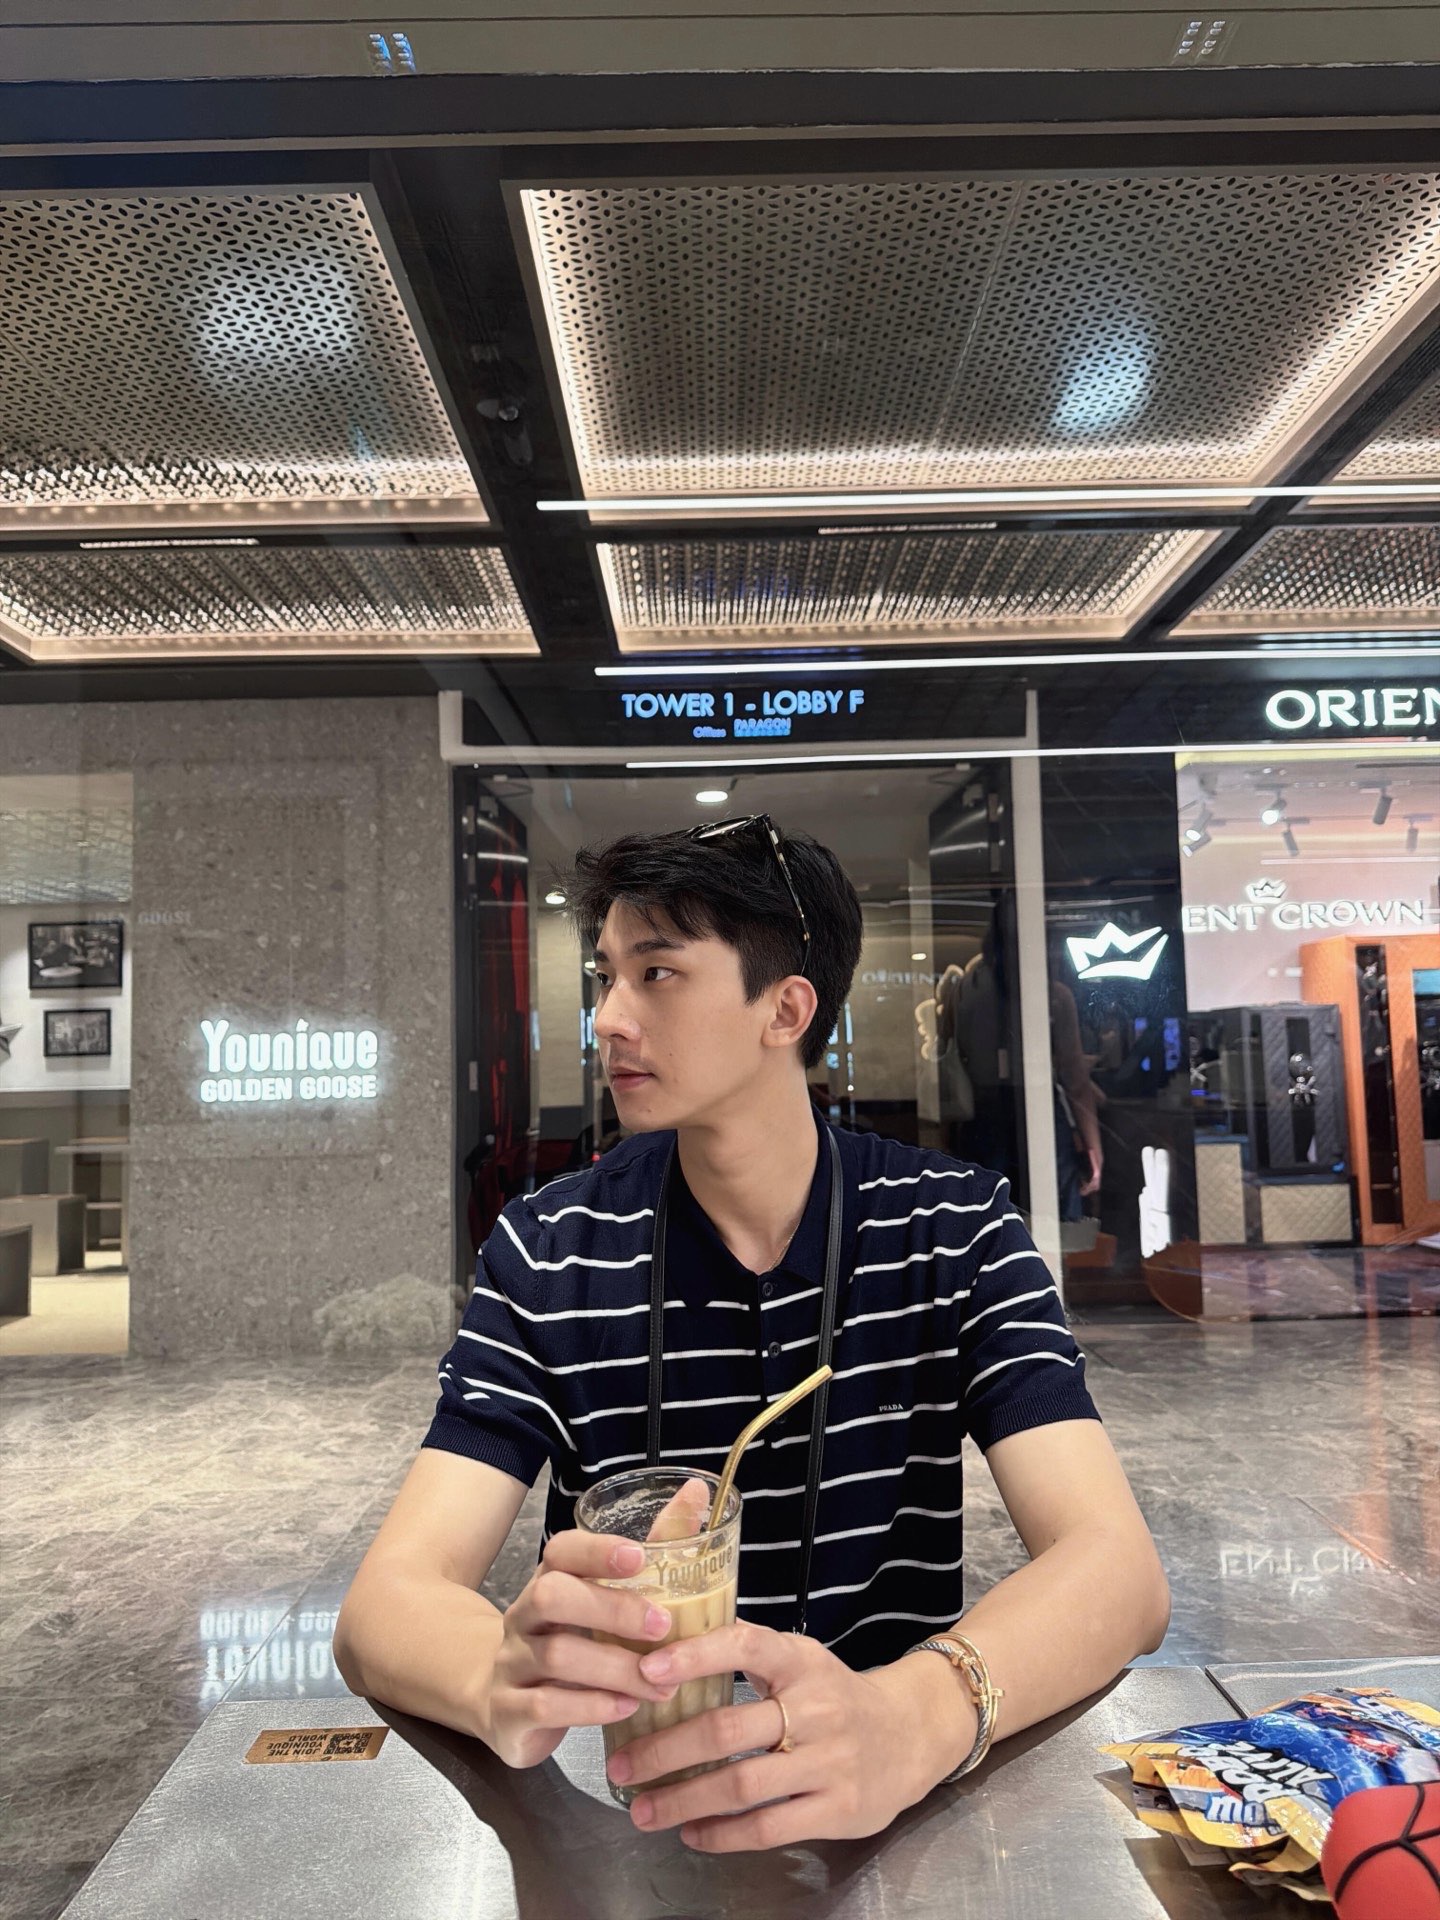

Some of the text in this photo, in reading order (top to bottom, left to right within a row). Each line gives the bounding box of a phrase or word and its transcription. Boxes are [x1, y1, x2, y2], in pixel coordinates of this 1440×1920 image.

[621, 692, 715, 718] TOWER
[723, 692, 734, 716] 1
[762, 690, 843, 715] LOBBY
[849, 689, 865, 713] F
[1265, 687, 1440, 729] ORIEN
[1182, 900, 1424, 933] ENT CROWN
[200, 1018, 378, 1073] Younique
[200, 1075, 377, 1103] GOLDEN GOOSE
[878, 1403, 904, 1412] PRADA
[654, 1545, 734, 1587] Younique
[267, 1741, 322, 1749] YOUNIQUE
